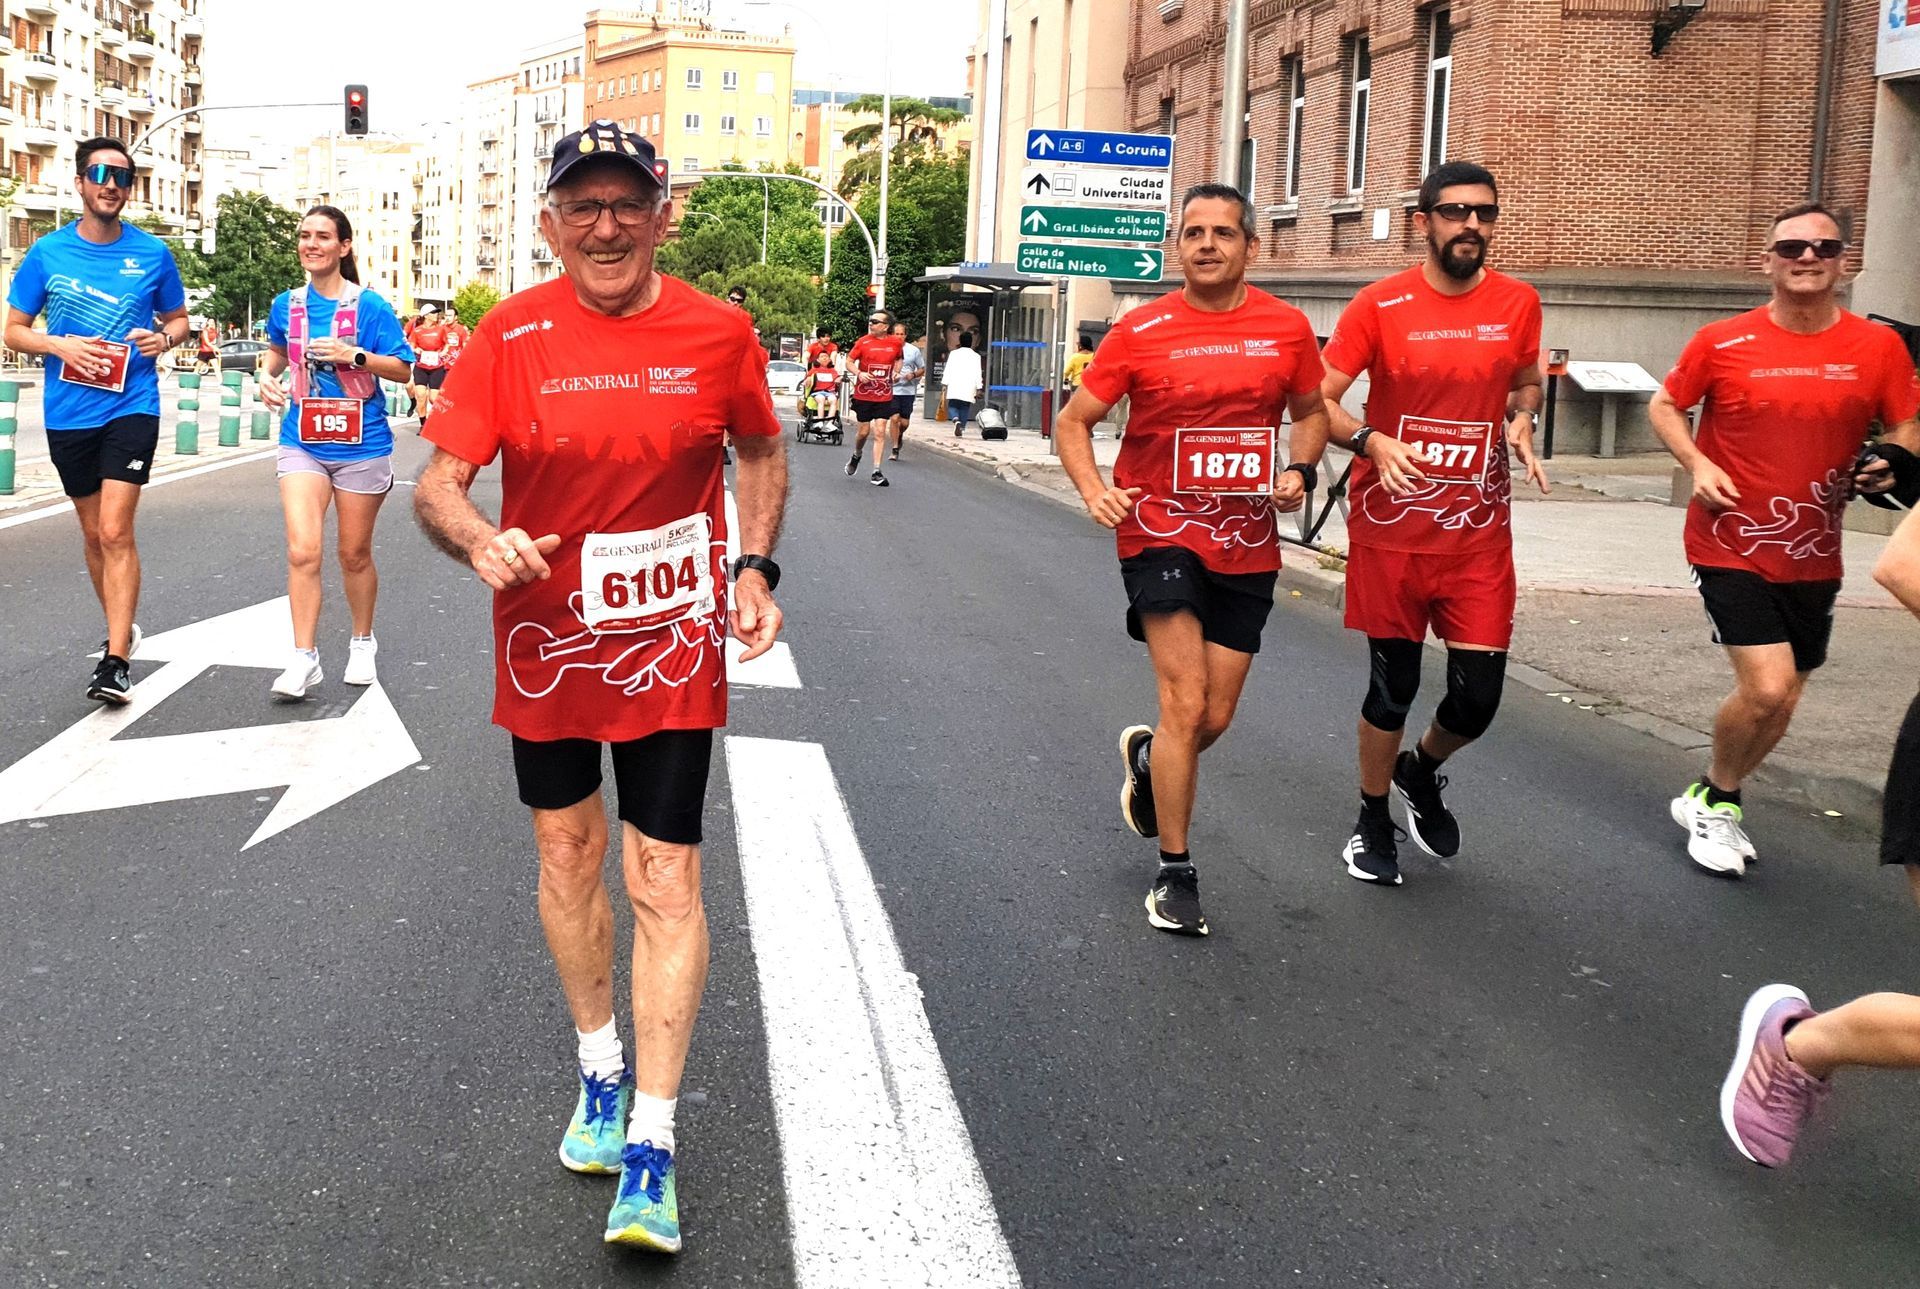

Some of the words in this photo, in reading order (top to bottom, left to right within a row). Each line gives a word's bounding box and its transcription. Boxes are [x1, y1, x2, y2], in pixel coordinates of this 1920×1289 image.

[1061, 141, 1082, 151] A-6
[1101, 142, 1111, 154] A
[1115, 143, 1167, 157] Coruña
[1120, 177, 1164, 189] Ciudad
[1082, 187, 1162, 201] Universitaria
[1114, 215, 1141, 225] calle
[1143, 216, 1161, 225] del
[1080, 223, 1115, 235] Ibáñez
[1116, 226, 1131, 235] de
[1022, 247, 1049, 256] calle
[1051, 248, 1065, 257] de
[1021, 257, 1065, 270] Ofelia
[1068, 260, 1107, 273] Nieto
[1422, 329, 1472, 340] GENERALI
[1184, 344, 1239, 357] GENERALI
[1243, 340, 1263, 348] 10K
[561, 374, 639, 392] GENERALI
[648, 367, 673, 380] 10K
[312, 414, 348, 433] 195
[1195, 435, 1236, 444] GENERALI
[1189, 452, 1261, 478] 1878
[609, 538, 662, 557] GENERALI
[602, 555, 699, 609] 6104
